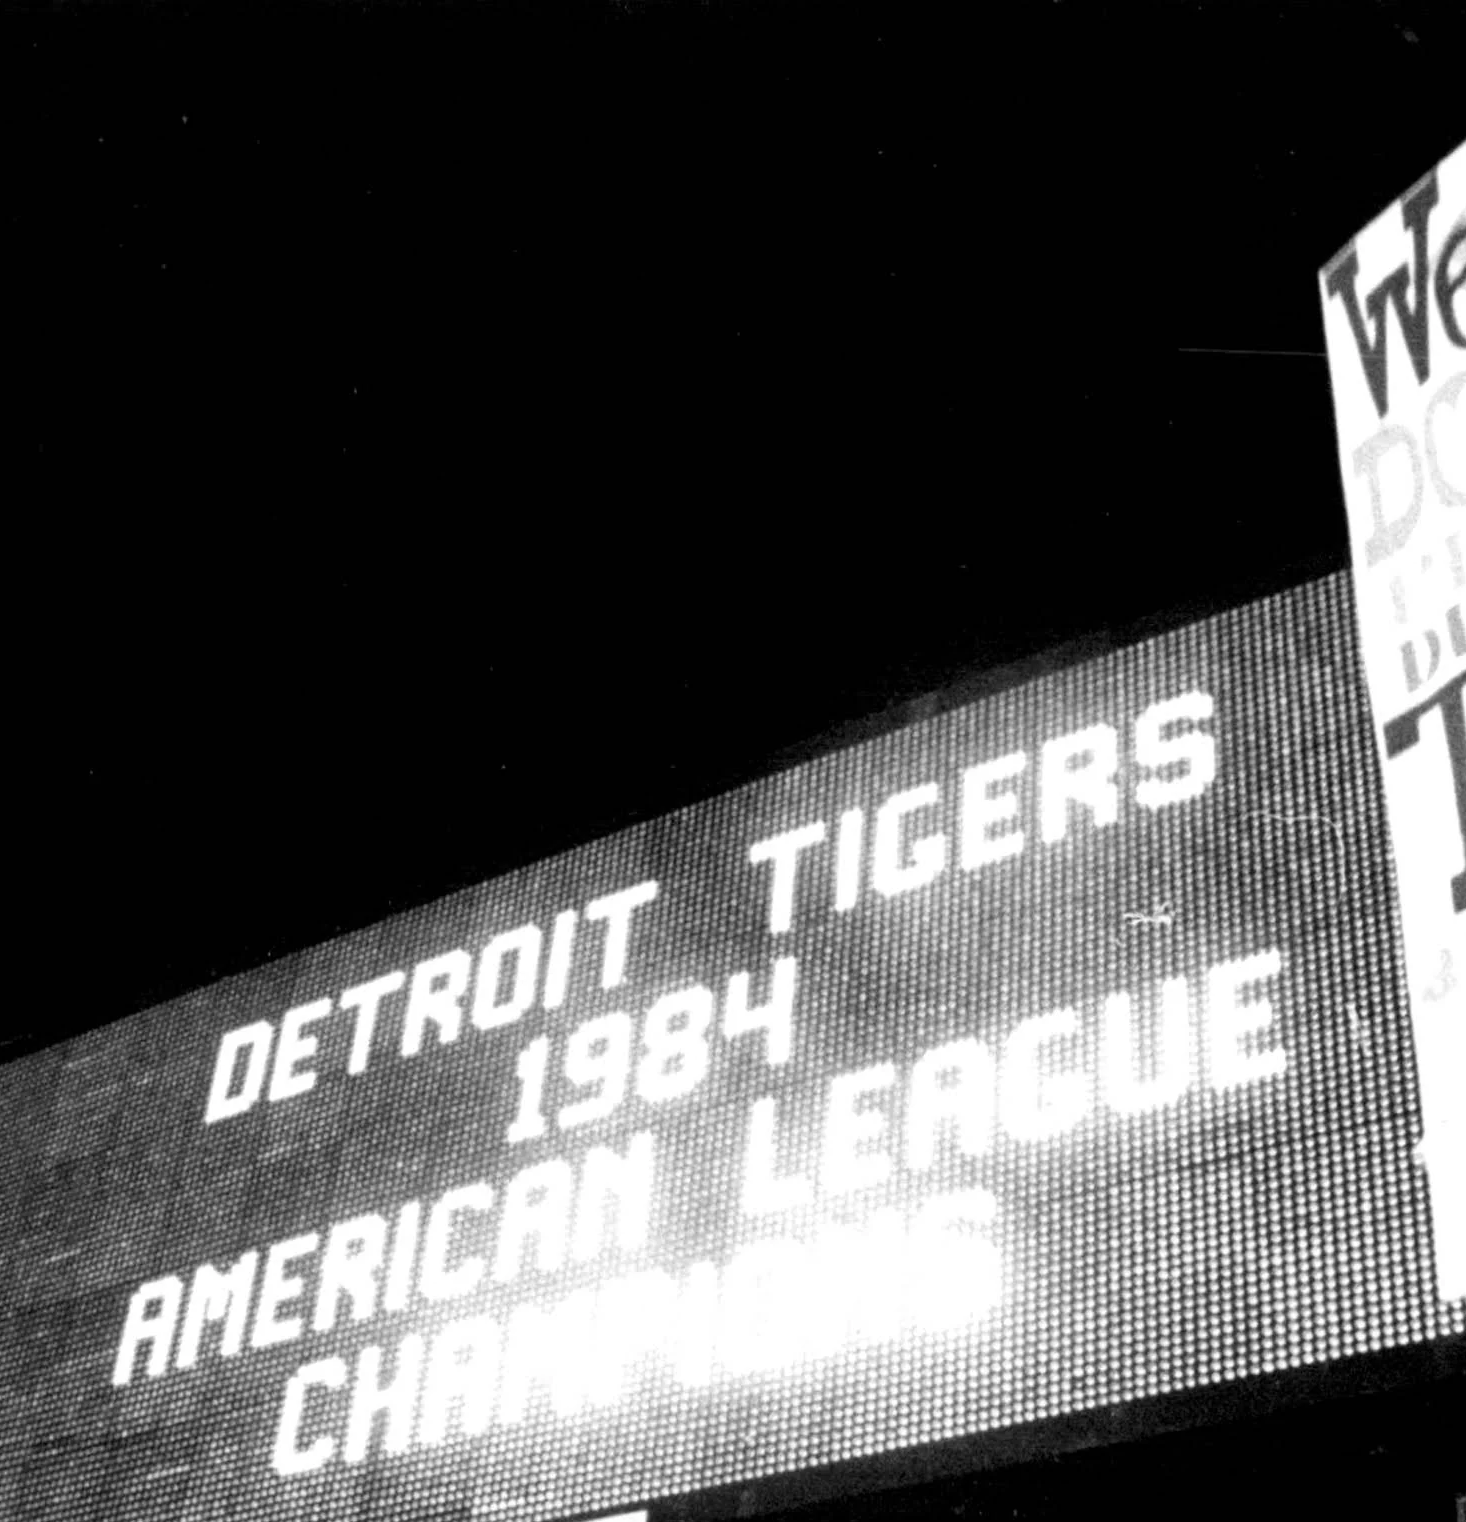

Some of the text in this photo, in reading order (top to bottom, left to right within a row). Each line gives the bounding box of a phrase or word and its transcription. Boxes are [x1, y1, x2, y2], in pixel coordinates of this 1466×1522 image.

[204, 879, 659, 1126] DETROIT
[749, 689, 1220, 936] TIGERS
[506, 954, 798, 1144] 1984
[112, 948, 1290, 1388] AMERICAN LEAGUE
